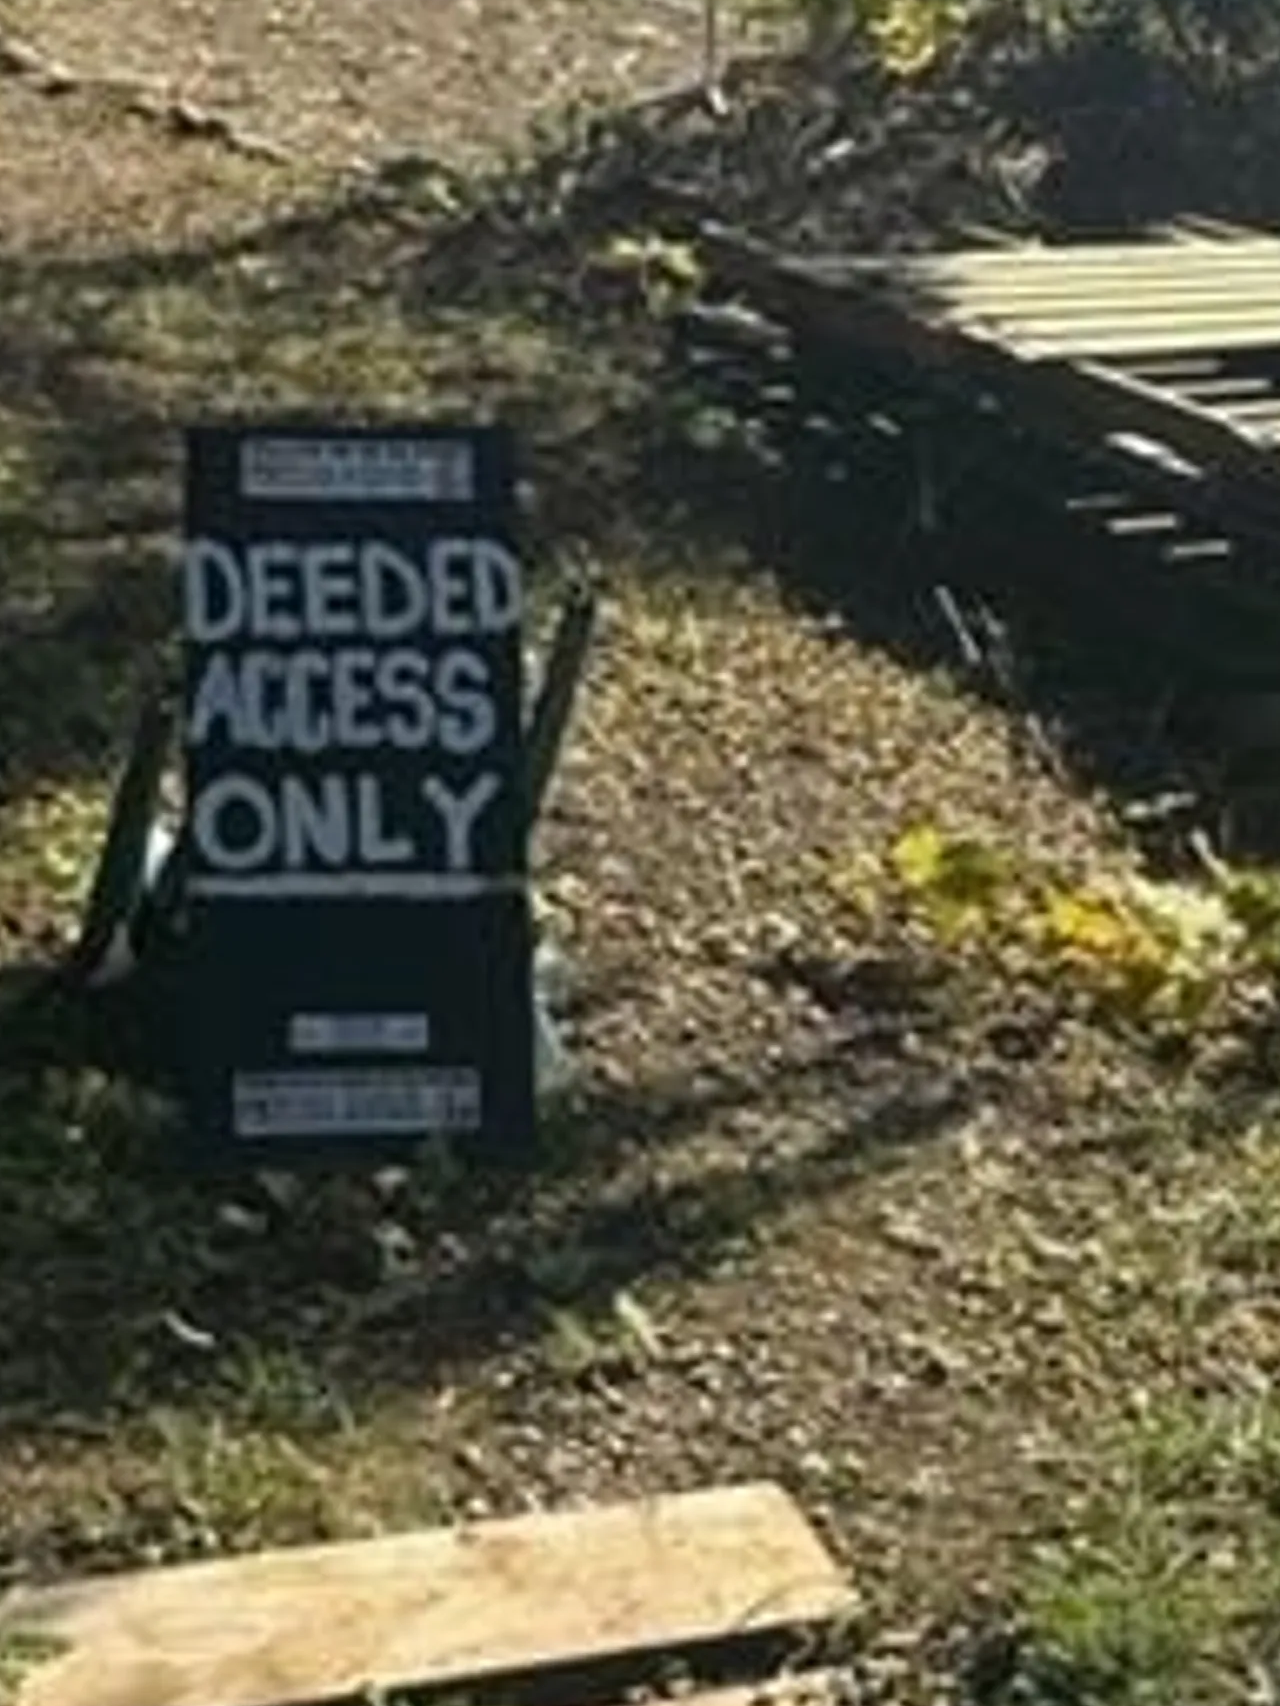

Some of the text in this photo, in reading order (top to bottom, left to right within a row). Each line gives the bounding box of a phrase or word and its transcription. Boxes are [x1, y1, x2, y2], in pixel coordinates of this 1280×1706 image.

[185, 537, 521, 640] DEEDED
[189, 649, 497, 752] ACCESS
[194, 773, 503, 869] ONLY
